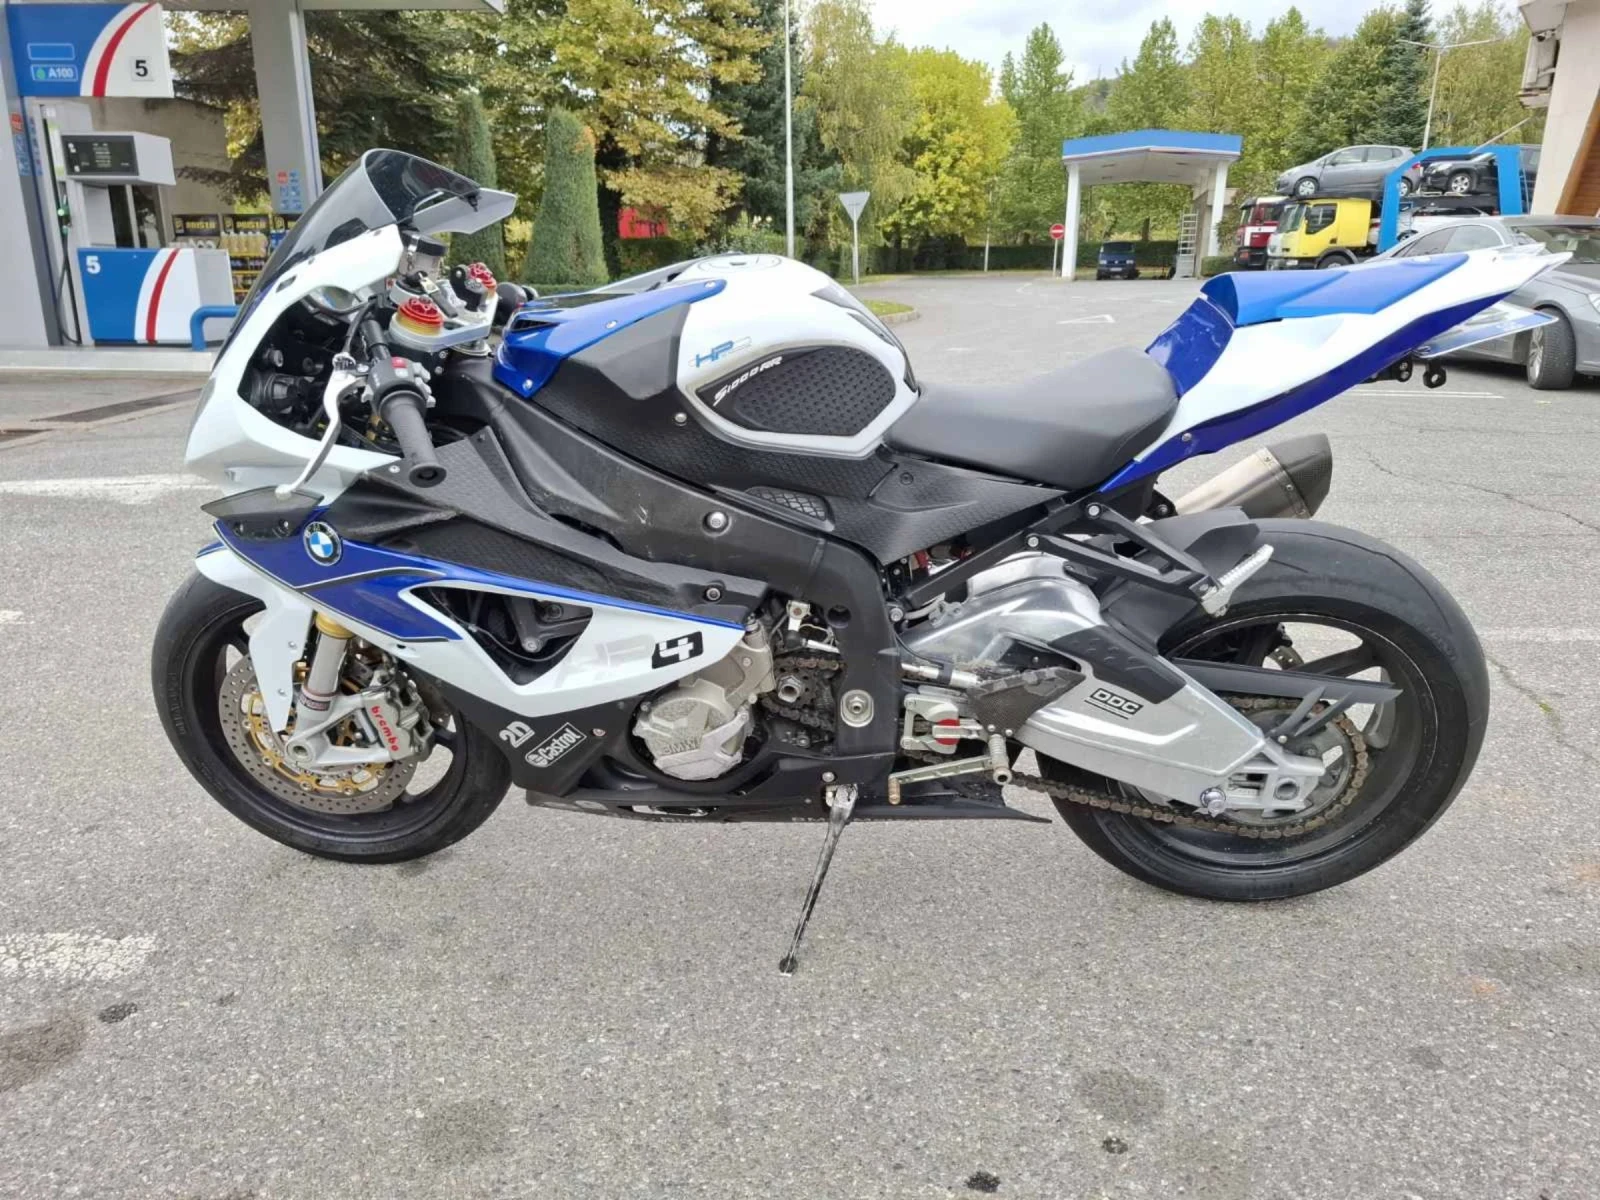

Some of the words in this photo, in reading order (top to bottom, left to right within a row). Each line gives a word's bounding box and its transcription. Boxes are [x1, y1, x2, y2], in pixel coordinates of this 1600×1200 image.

[48, 67, 74, 79] A100
[135, 59, 148, 77] 5
[86, 255, 101, 274] 5
[695, 340, 734, 368] HP
[1092, 689, 1141, 713] DDC
[499, 721, 536, 749] 2D
[537, 727, 582, 761] Castrol
